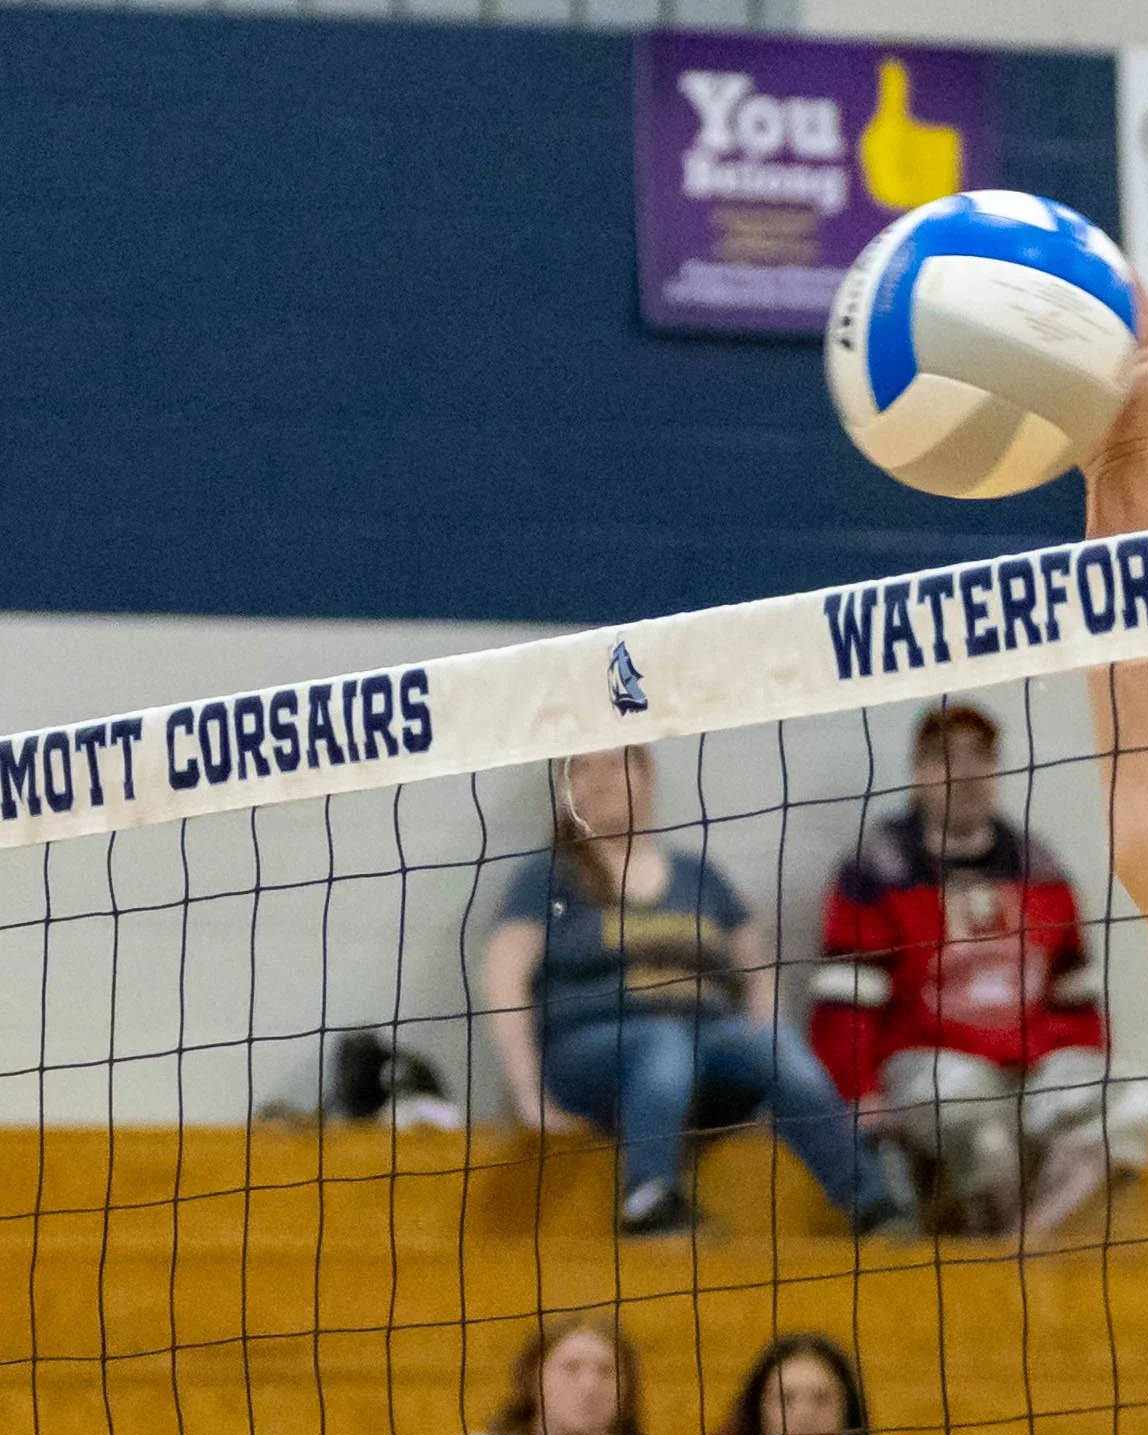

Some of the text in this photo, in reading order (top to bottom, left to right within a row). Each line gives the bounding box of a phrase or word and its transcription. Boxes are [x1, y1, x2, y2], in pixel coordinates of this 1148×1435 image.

[678, 70, 844, 156] You
[0, 668, 433, 820] MOTT CORSAIRS
